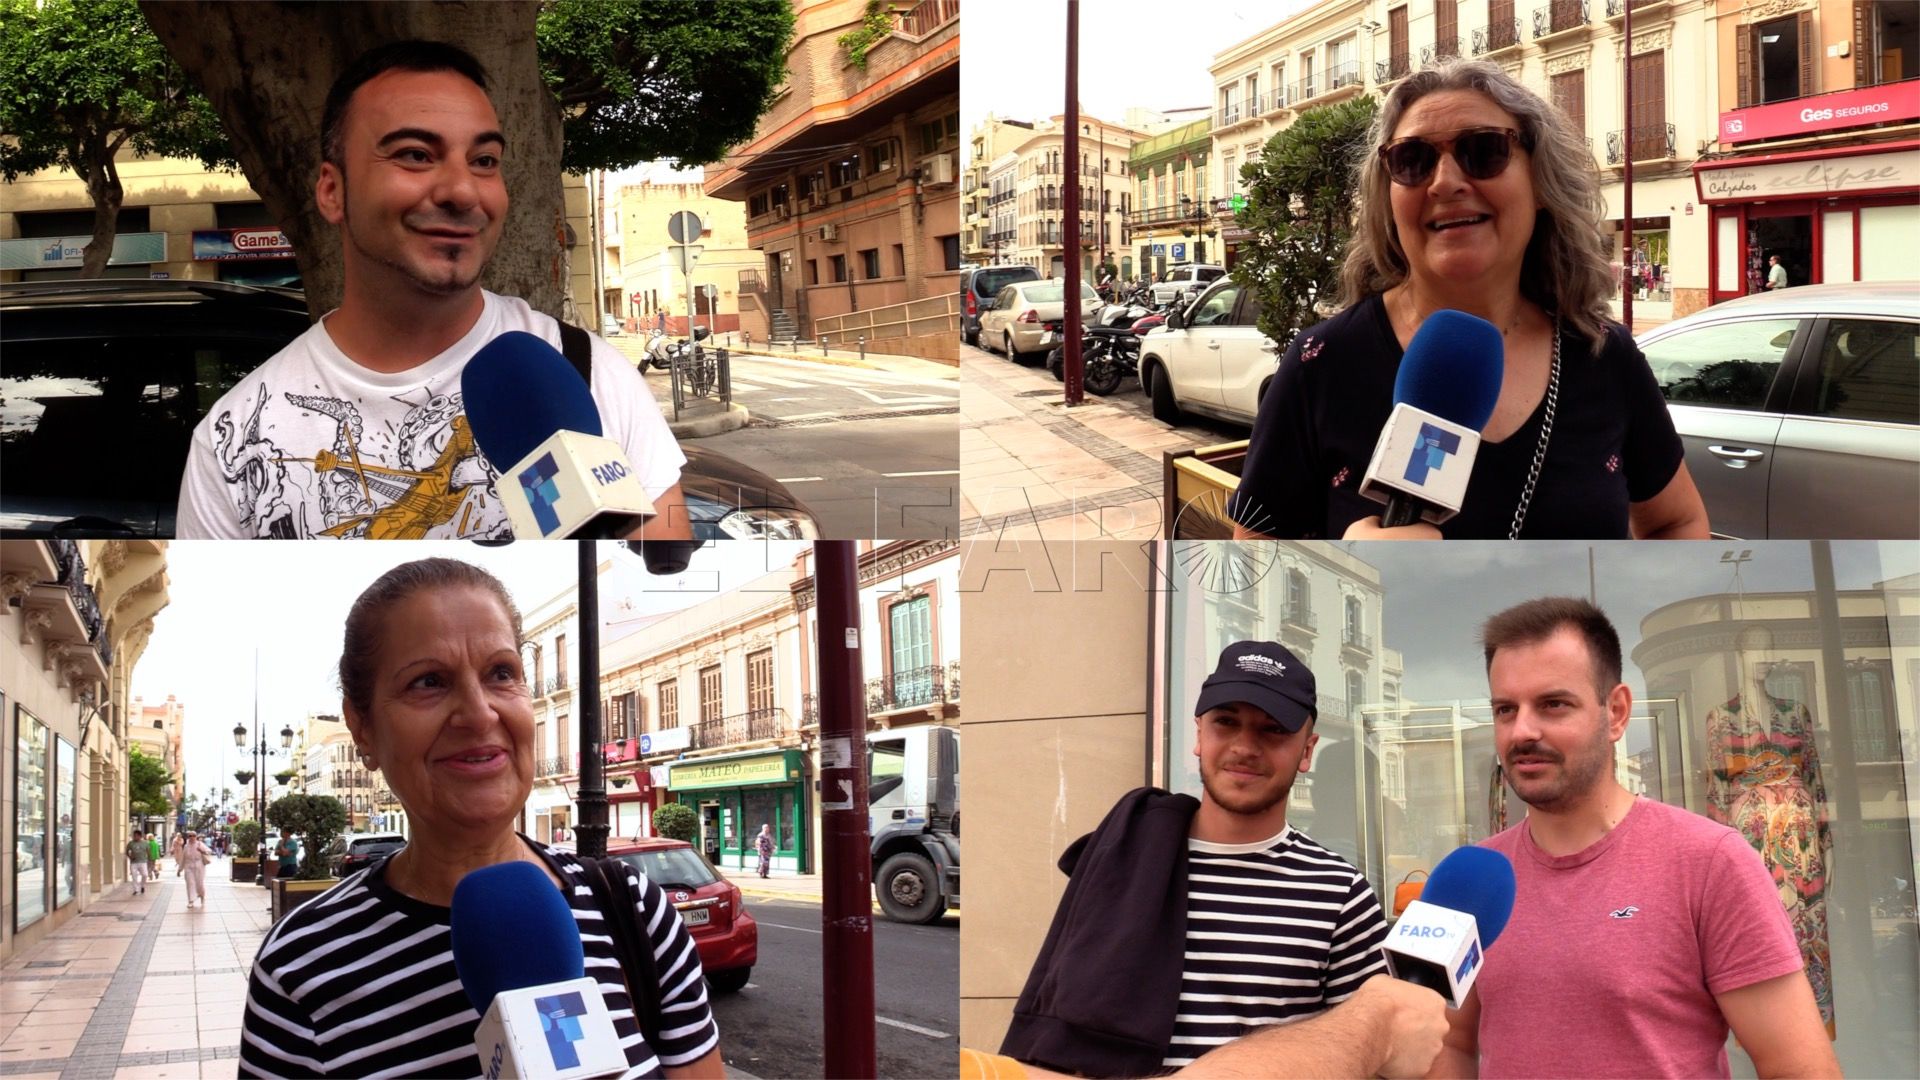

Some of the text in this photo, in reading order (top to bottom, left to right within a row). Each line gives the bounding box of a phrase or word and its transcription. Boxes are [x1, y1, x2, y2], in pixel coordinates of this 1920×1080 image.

[1800, 102, 1889, 123] Ges SEGUROS
[1766, 163, 1901, 189] eclipse
[1709, 180, 1757, 197] Calzados
[591, 460, 626, 486] FARO
[1238, 654, 1273, 665] adidas
[699, 762, 741, 778] MATEO
[1400, 924, 1446, 938] FARO
